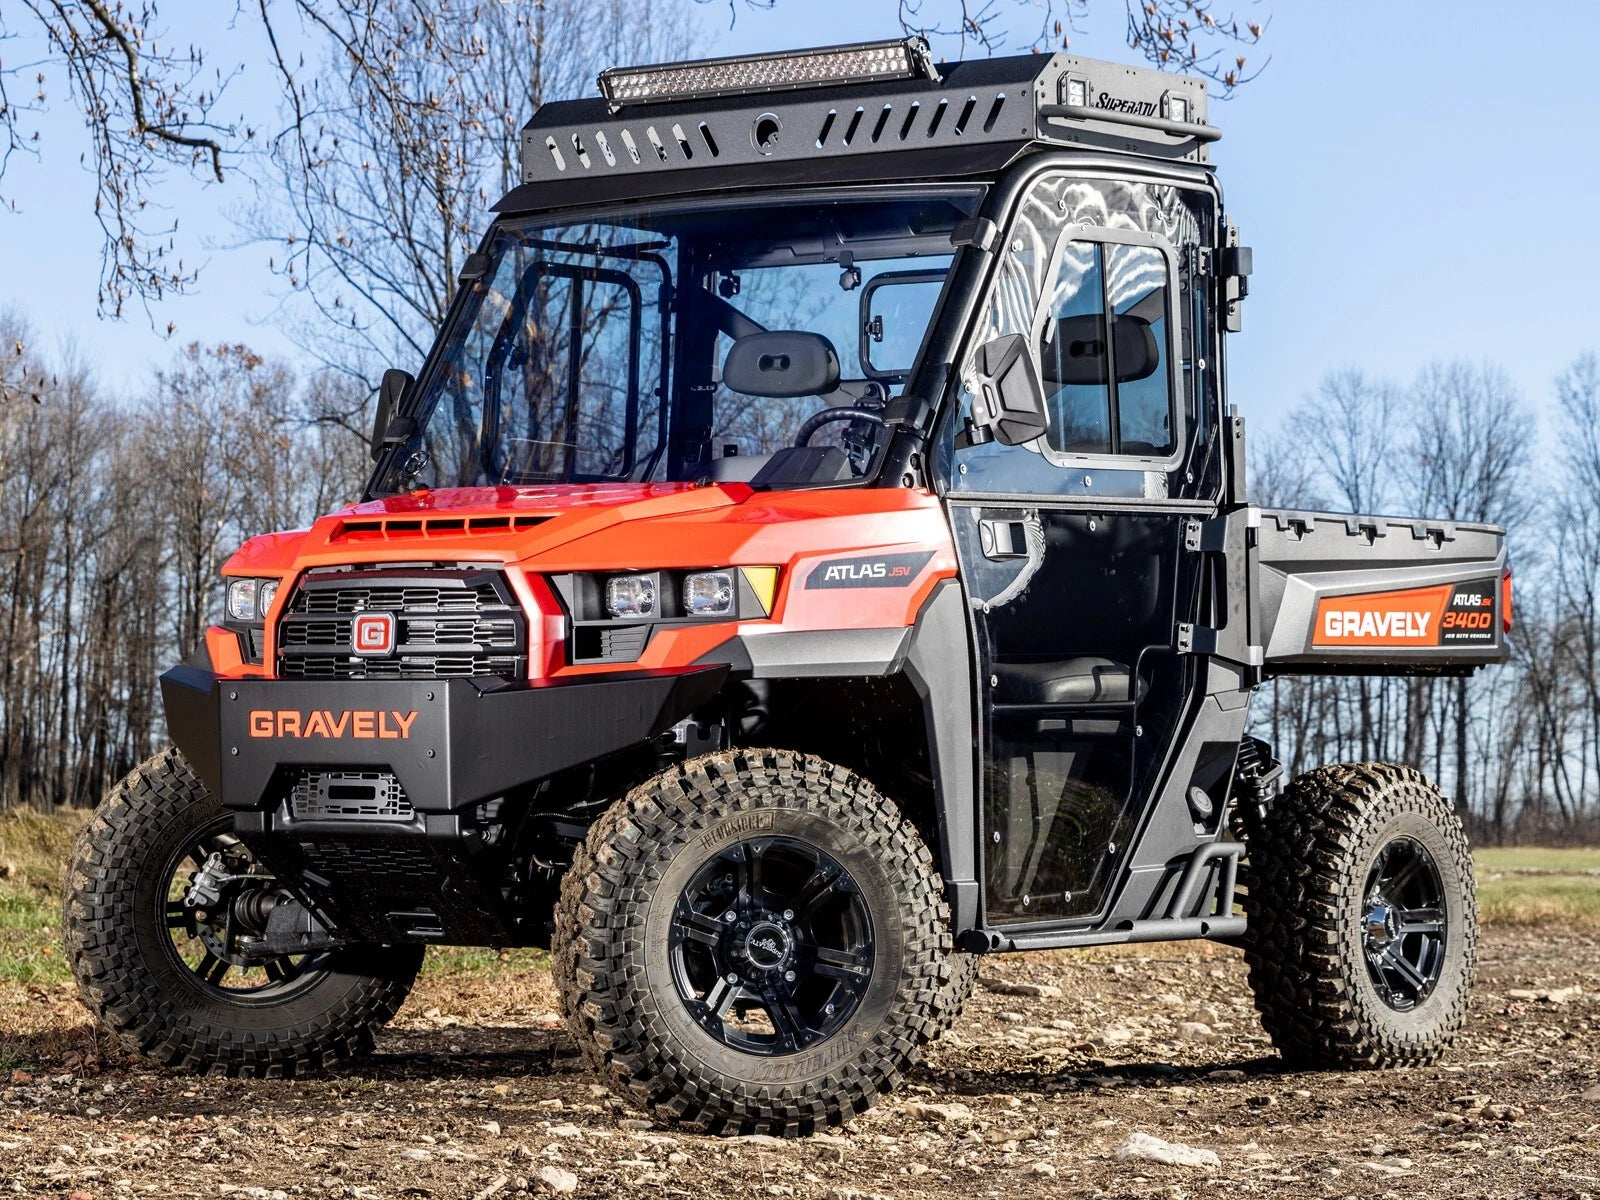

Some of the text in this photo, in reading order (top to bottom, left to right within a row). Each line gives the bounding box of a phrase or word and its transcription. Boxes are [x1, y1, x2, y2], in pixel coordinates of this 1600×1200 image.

[824, 563, 911, 581] ATLAS JSV
[1453, 594, 1482, 606] ATLAS
[1325, 611, 1431, 637] GRAVELY
[1443, 612, 1492, 628] 3400
[362, 622, 386, 646] G
[249, 710, 419, 739] GRAVELY
